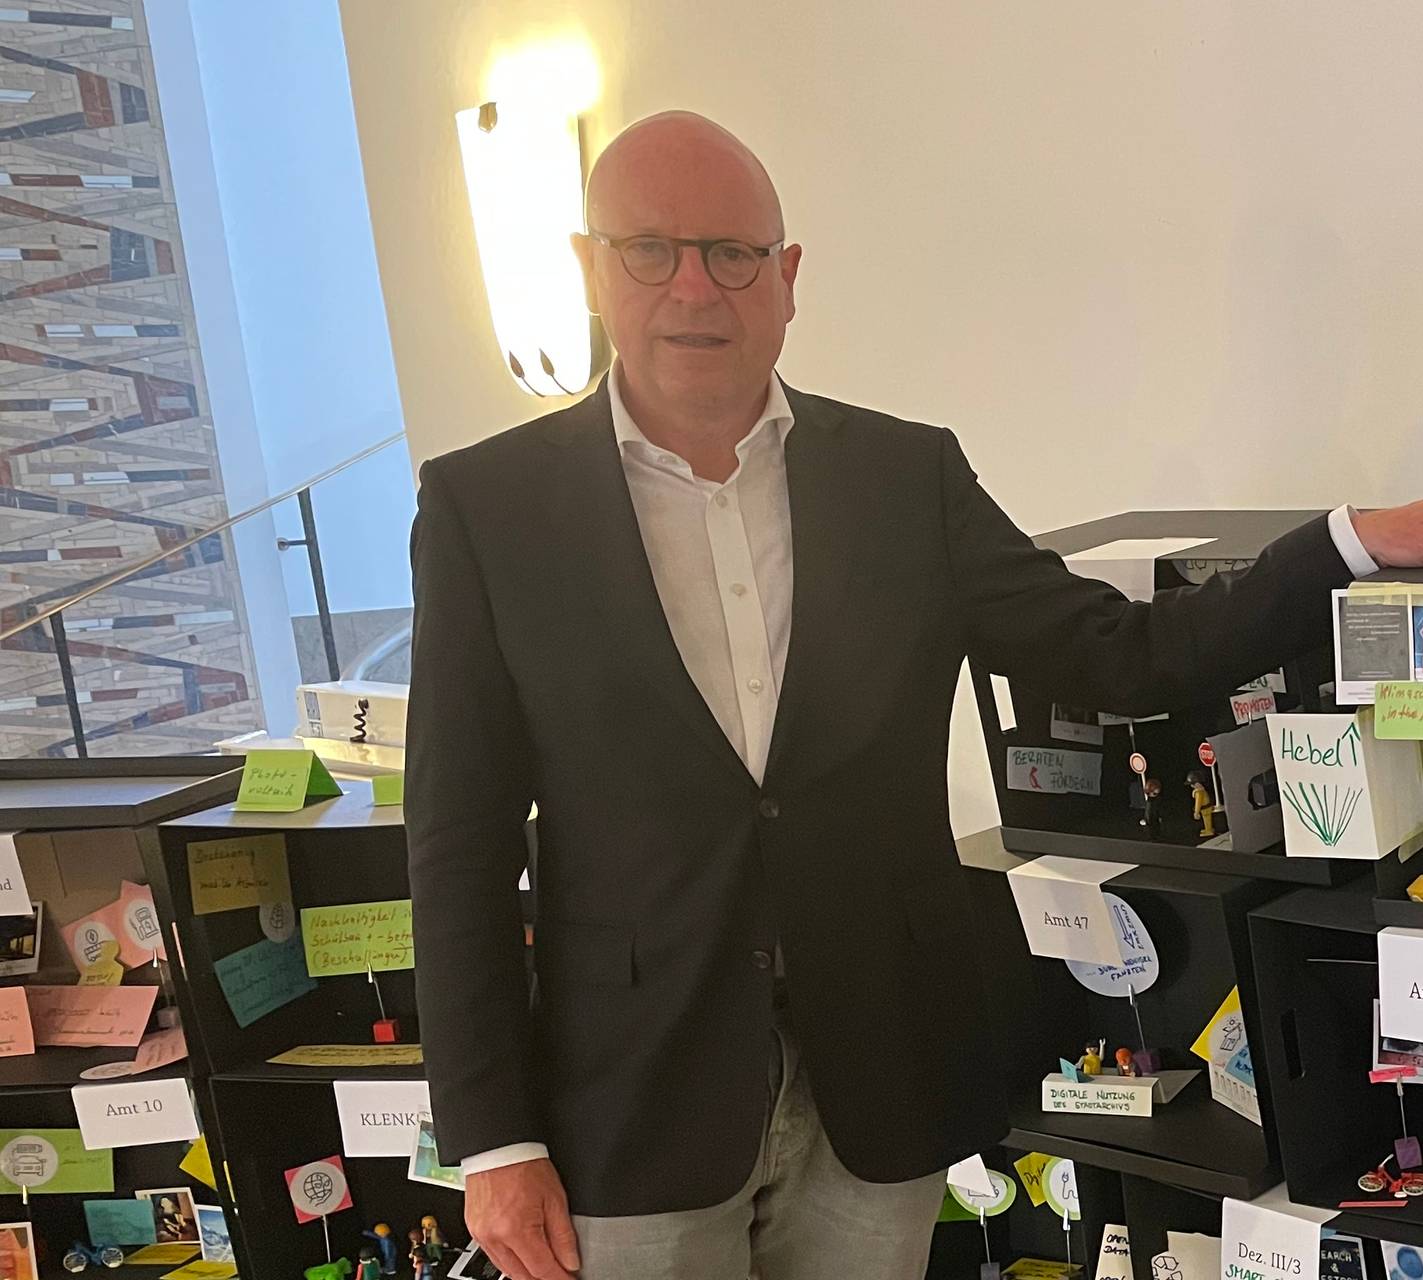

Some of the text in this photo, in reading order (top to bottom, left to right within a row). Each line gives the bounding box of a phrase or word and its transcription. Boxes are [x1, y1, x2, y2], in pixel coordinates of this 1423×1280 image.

[1282, 727, 1343, 767] Hebel
[1013, 750, 1065, 768] BERATEN
[1044, 911, 1089, 930] Amt 47
[1050, 1088, 1136, 1101] DIGITALE NUTZUNG
[106, 1099, 163, 1117] Amt 10
[1238, 1242, 1301, 1275] Dez. III/3
[1320, 1250, 1352, 1262] EARCH
